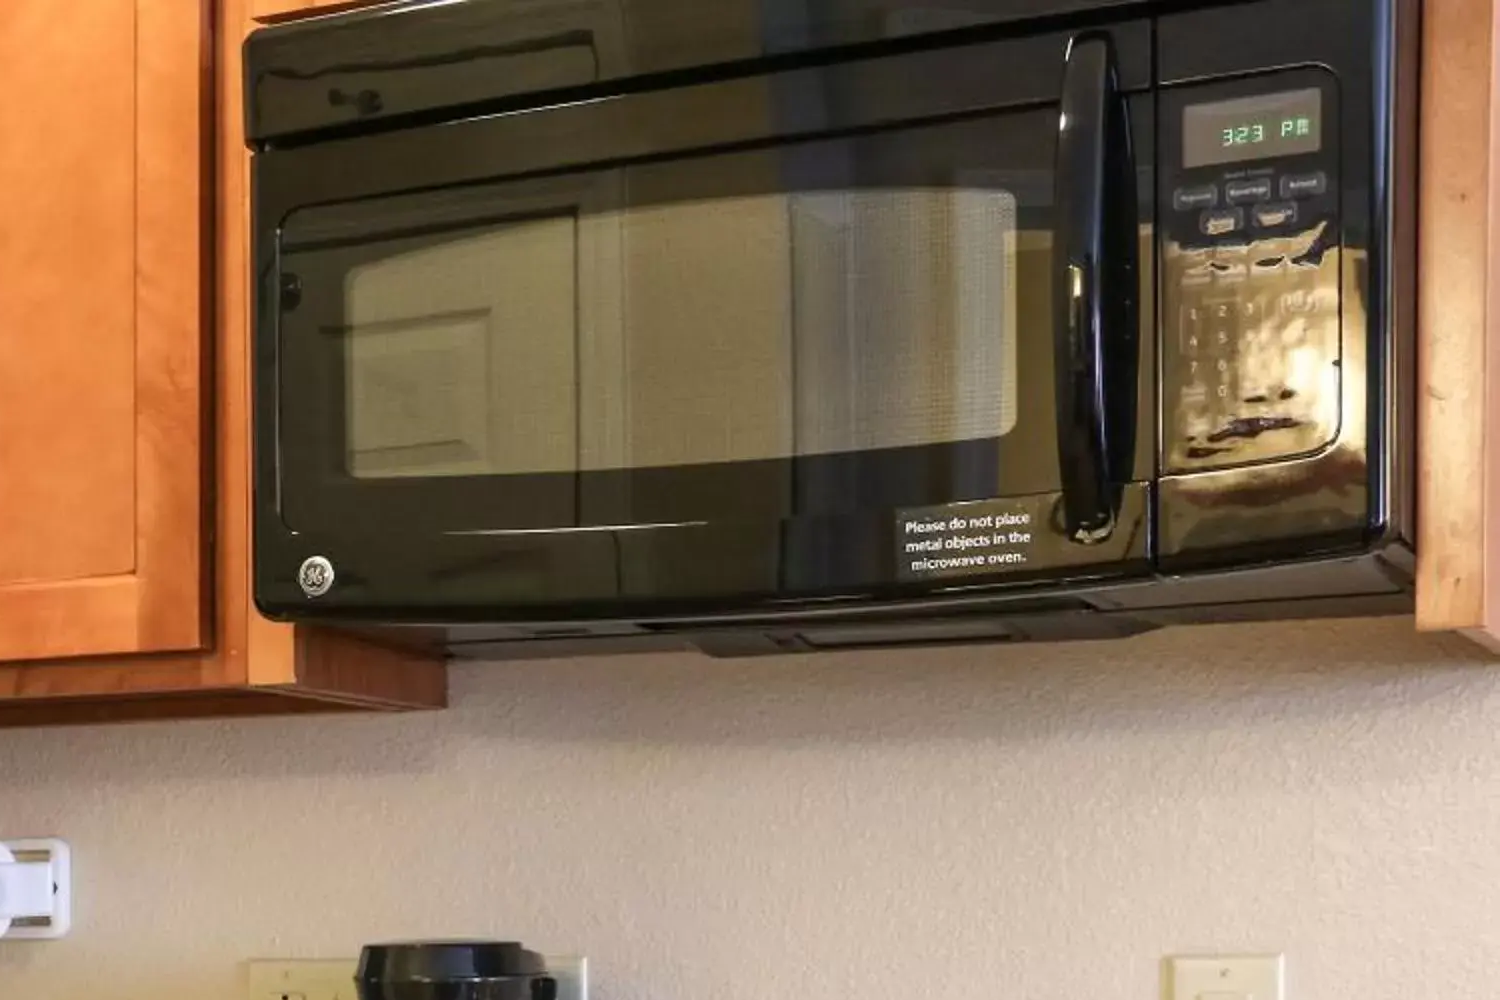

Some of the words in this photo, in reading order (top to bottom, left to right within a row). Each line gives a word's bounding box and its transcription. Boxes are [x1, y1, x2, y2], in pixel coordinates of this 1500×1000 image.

[905, 520, 947, 533] Please
[950, 517, 967, 530] do
[969, 516, 994, 528] not
[995, 513, 1031, 529] place
[905, 538, 943, 552] metal
[945, 535, 990, 551] objects
[993, 533, 1006, 545] in
[1009, 531, 1031, 543] the
[911, 554, 985, 571] microwave
[987, 552, 1027, 565] oven.
